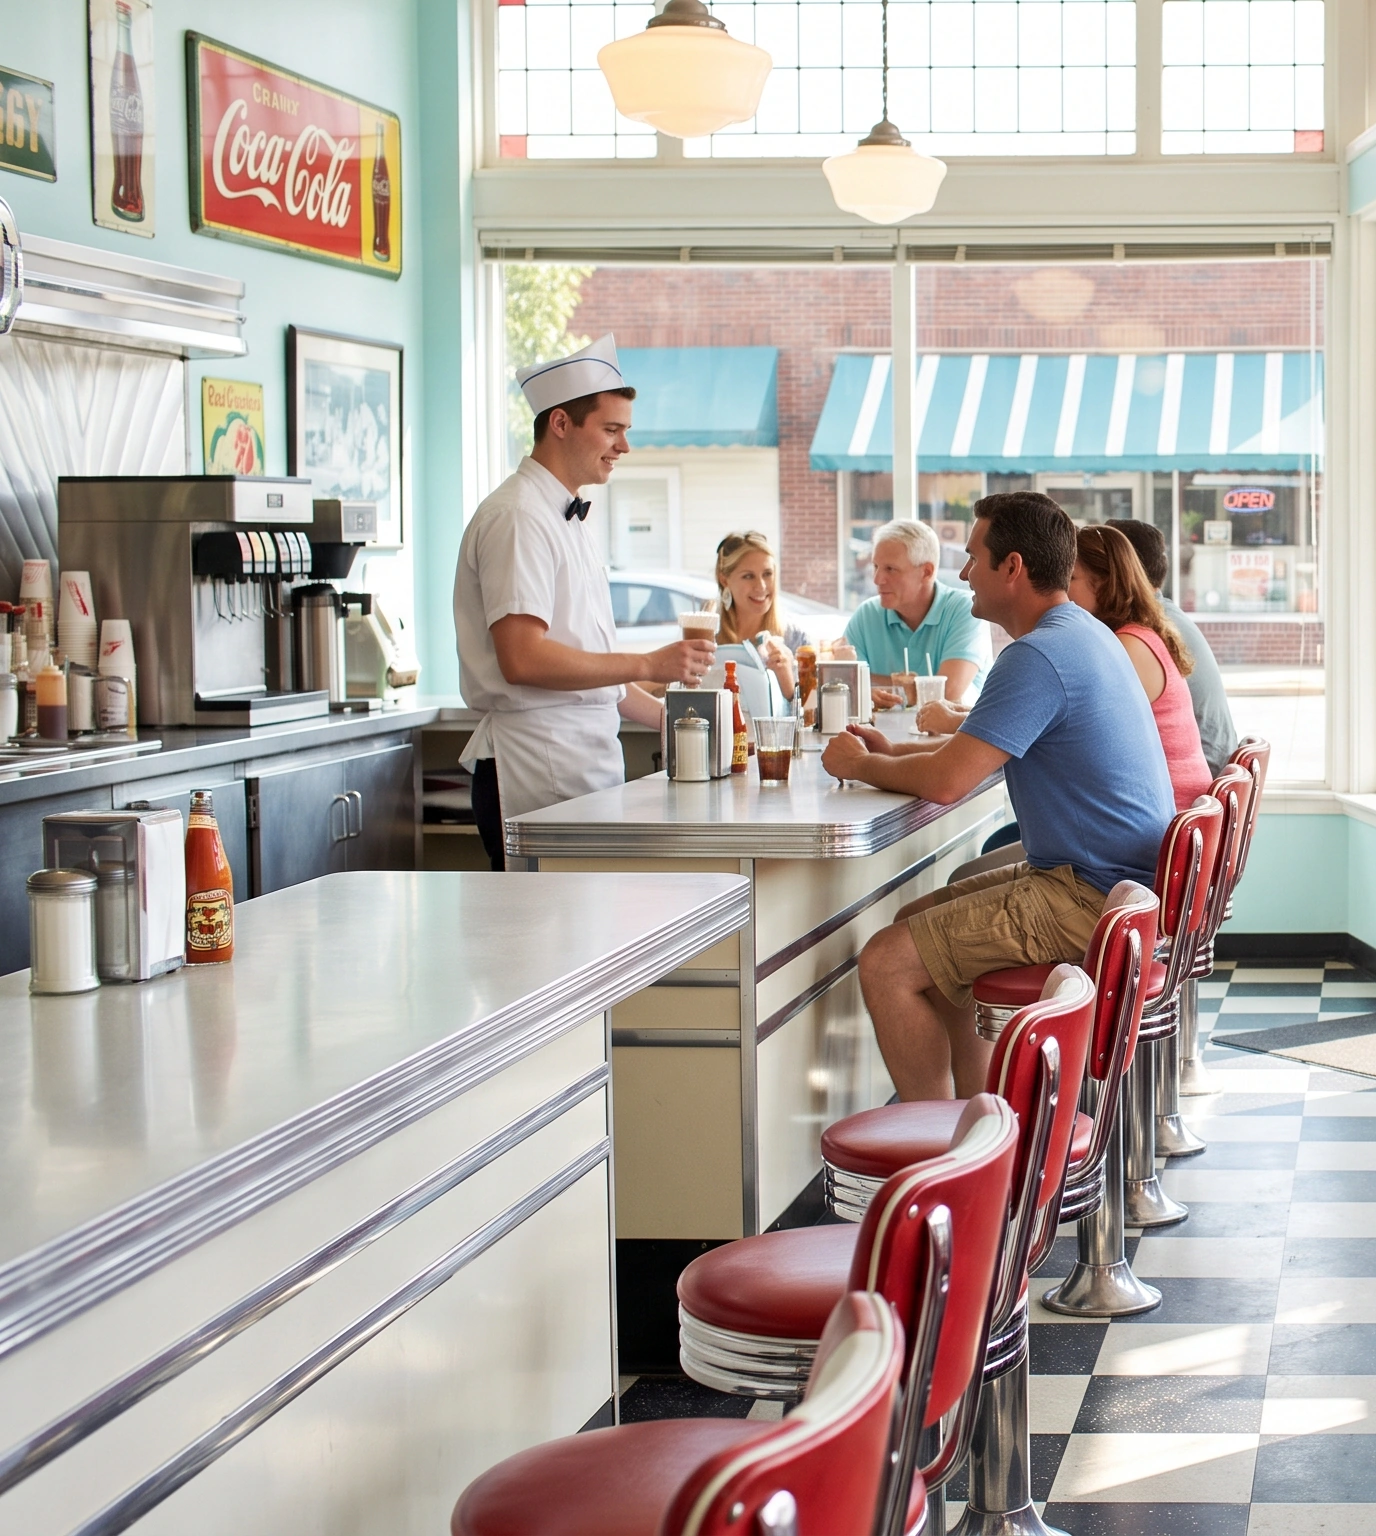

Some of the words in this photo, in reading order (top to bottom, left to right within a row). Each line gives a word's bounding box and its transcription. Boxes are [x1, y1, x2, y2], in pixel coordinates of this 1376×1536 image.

[0, 82, 43, 153] GY
[212, 98, 356, 228] Coca-Cola
[1223, 492, 1275, 509] OPEN
